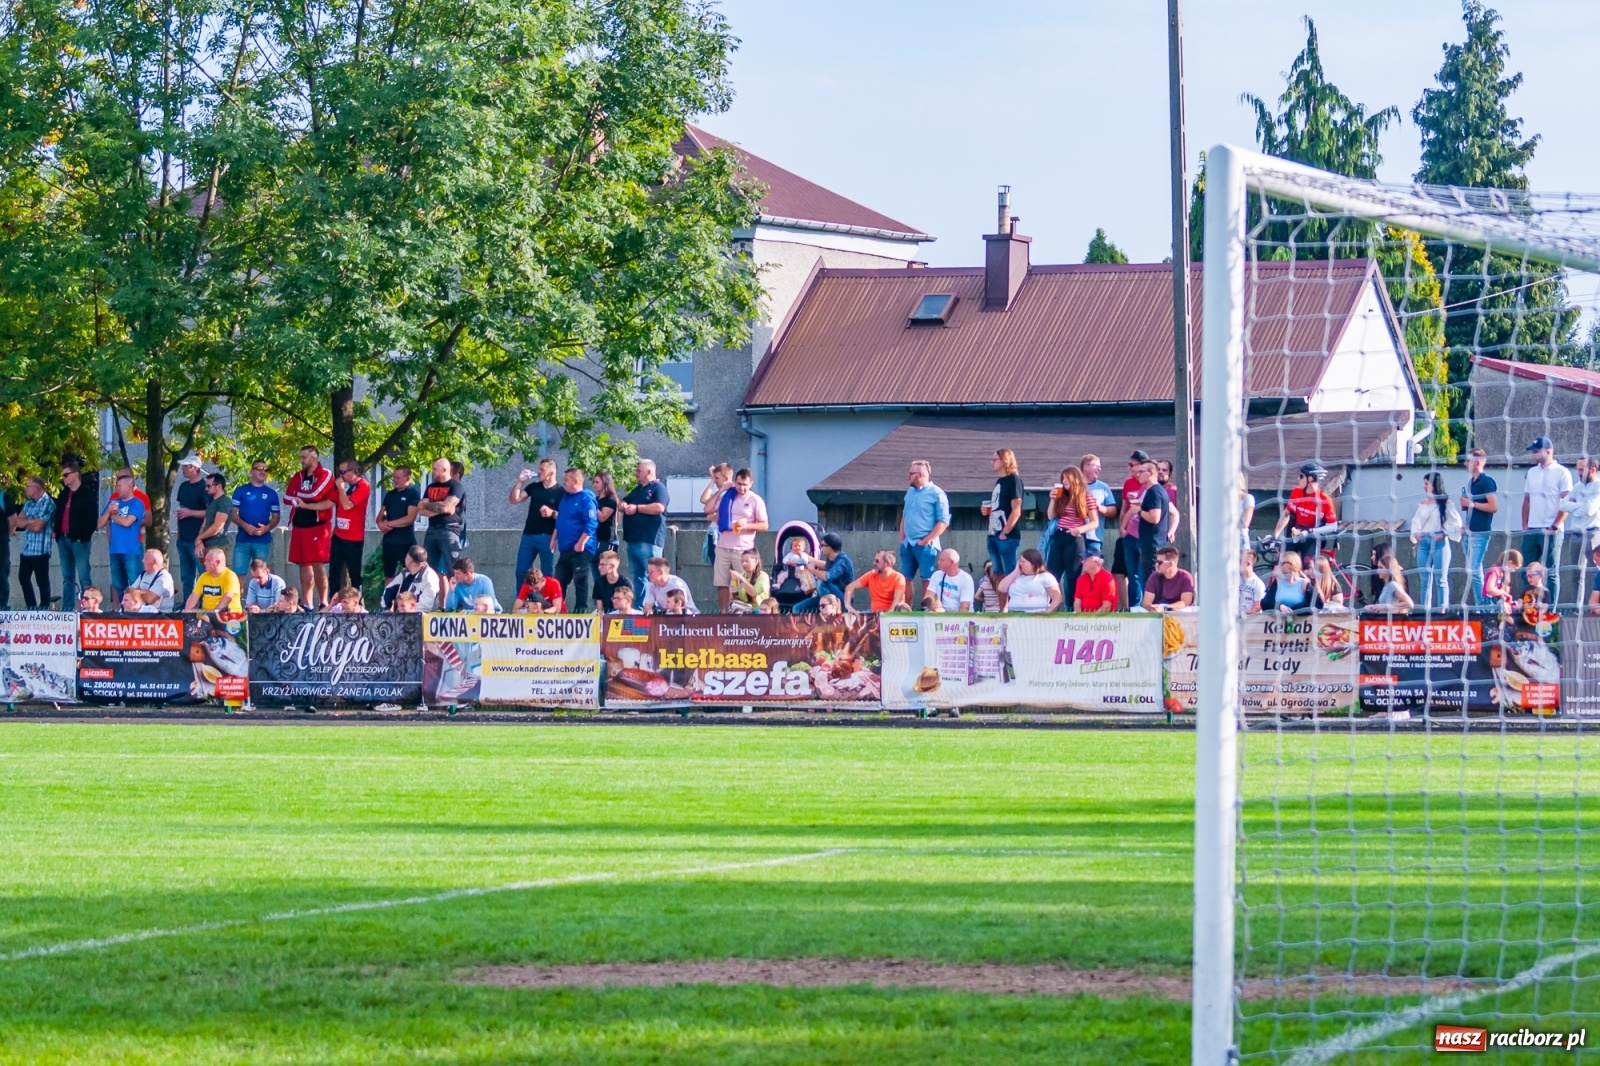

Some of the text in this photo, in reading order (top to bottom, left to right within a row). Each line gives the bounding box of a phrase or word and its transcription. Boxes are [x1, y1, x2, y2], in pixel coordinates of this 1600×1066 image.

[30, 613, 74, 622] HANOWIEC
[83, 622, 179, 639] KREWETKA
[429, 616, 468, 638] OKNA
[480, 618, 524, 638] DRZWI
[537, 618, 593, 639] SCHODY
[659, 624, 713, 637] Producent
[944, 624, 960, 632] H40
[1064, 623, 1088, 632] Poczuj
[1264, 621, 1312, 634] Kebab
[13, 633, 31, 644] 600
[55, 634, 73, 645] 516
[1364, 625, 1476, 642] KREWETKA
[140, 638, 179, 647] SMAŻALNIA
[1264, 638, 1310, 655] Frytki
[100, 650, 122, 658] ŚWIEŻE,
[280, 617, 375, 686] Alicja
[515, 647, 564, 656] Producent
[1054, 638, 1114, 664] H40
[659, 648, 768, 669] kiełbasa
[492, 664, 594, 674] www.oknadrzwischody.pl
[1082, 664, 1096, 673] BEZ
[1264, 658, 1301, 675] Lody
[703, 661, 812, 696] szefa
[262, 686, 403, 697] KRZYŻANOWICE, ŻANETA POLAK
[1296, 684, 1307, 692] 32
[1308, 684, 1325, 692] 729
[1328, 684, 1339, 692] 69
[1341, 684, 1353, 692] 69
[1103, 694, 1155, 703] KERAKOLL
[1268, 698, 1278, 706] ul.
[1281, 698, 1328, 709] Ogrodowa
